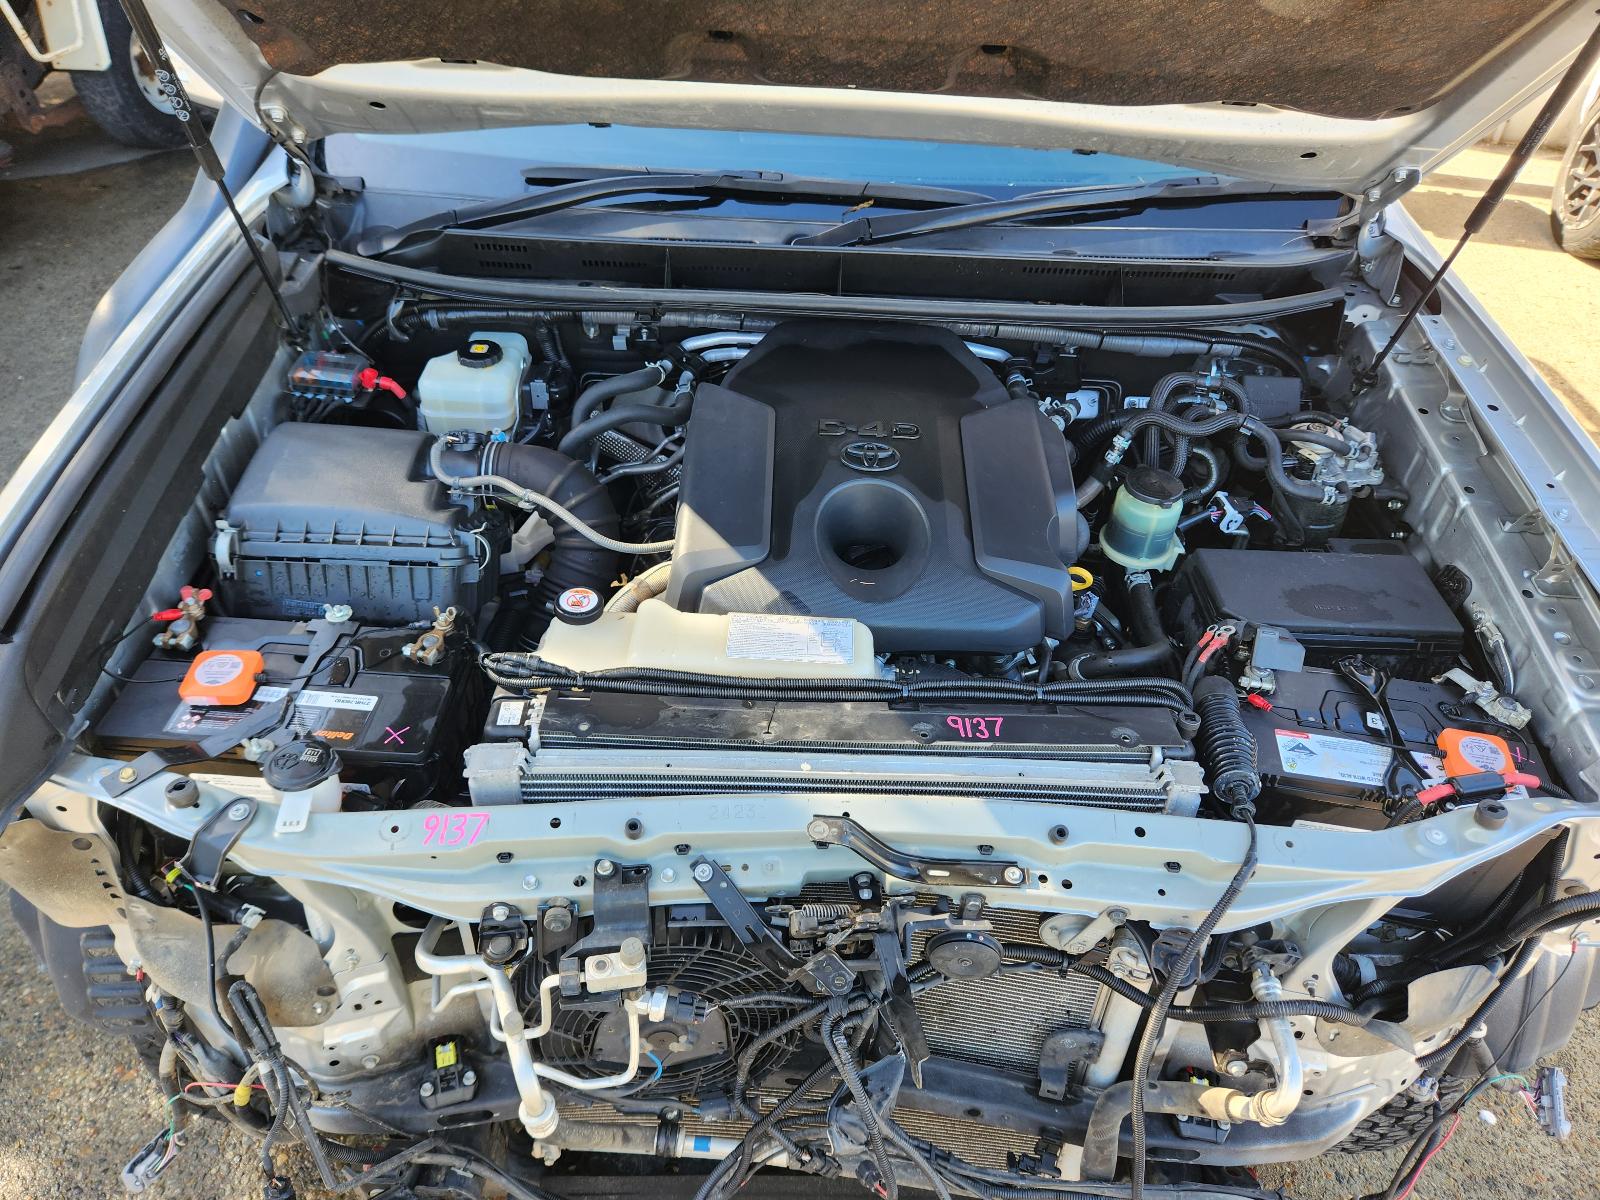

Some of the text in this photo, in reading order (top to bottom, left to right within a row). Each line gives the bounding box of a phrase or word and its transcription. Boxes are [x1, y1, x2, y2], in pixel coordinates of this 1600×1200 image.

[818, 419, 920, 439] D-4D
[946, 715, 1004, 739] 9137
[423, 812, 490, 848] 9137
